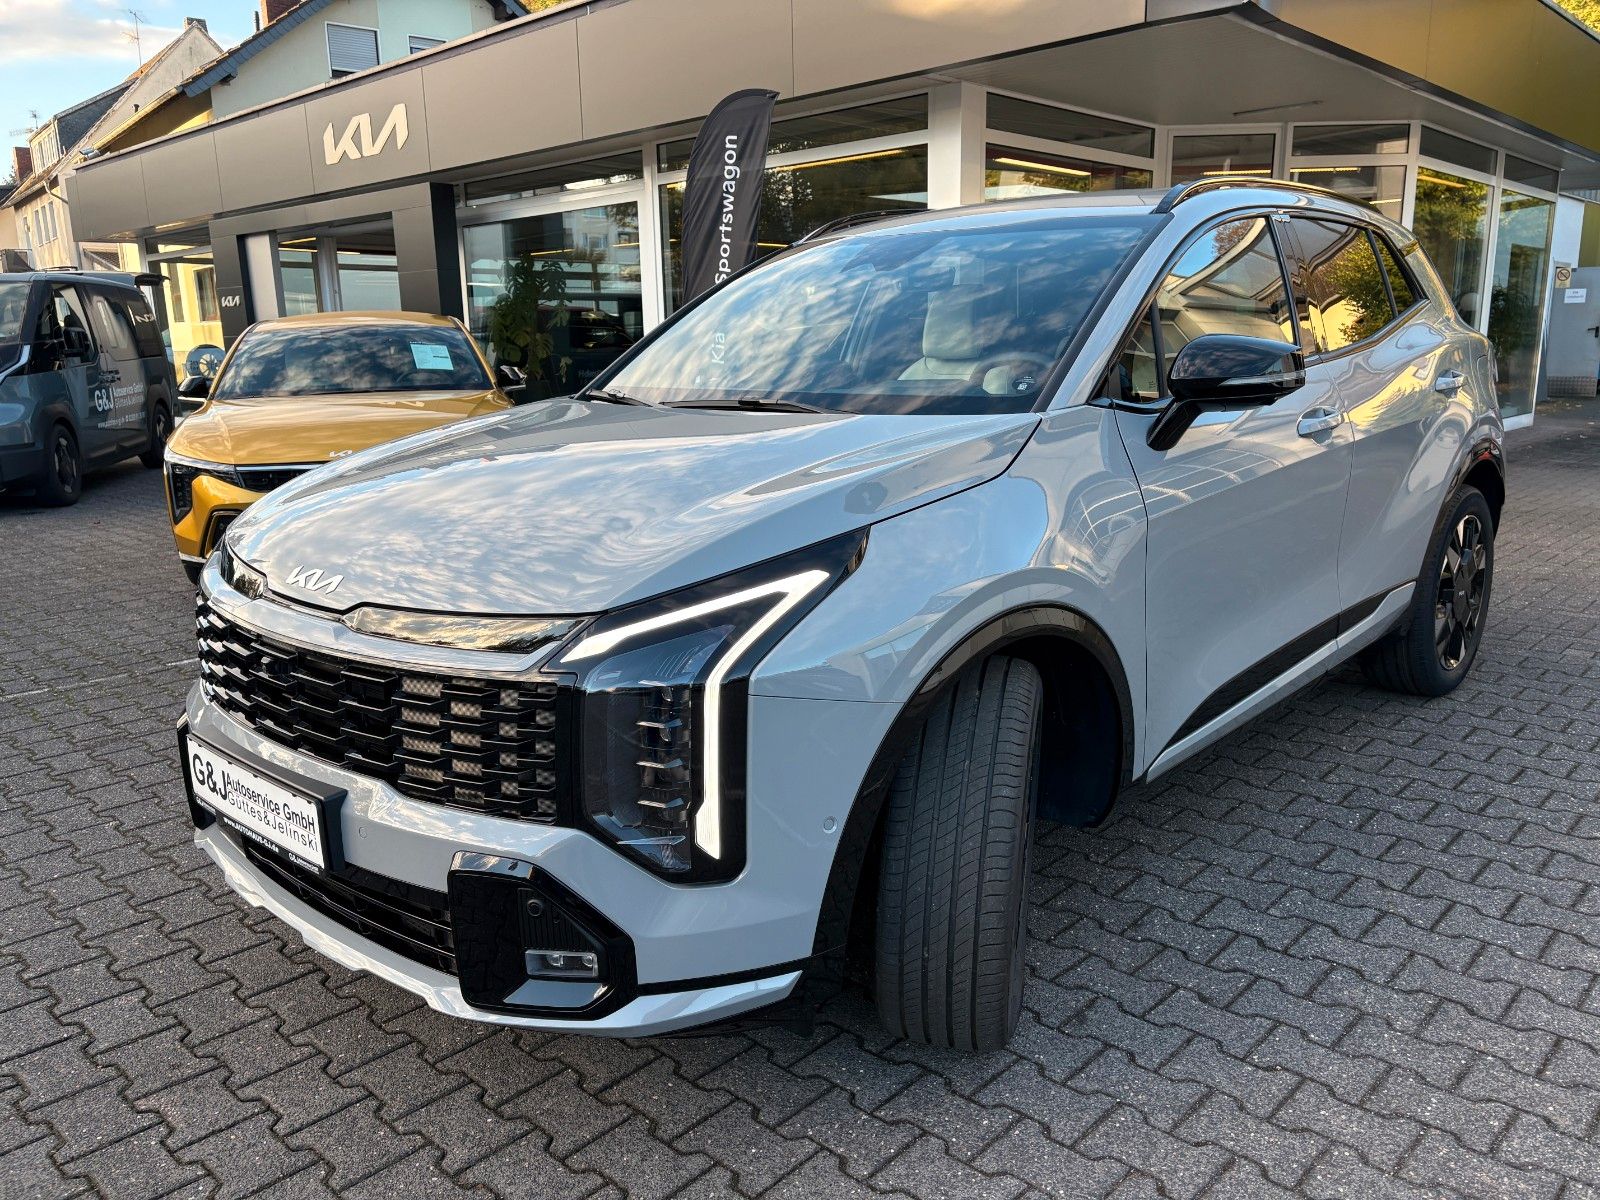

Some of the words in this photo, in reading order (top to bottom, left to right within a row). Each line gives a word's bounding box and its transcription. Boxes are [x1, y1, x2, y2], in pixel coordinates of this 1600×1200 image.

[323, 103, 409, 165] KIA
[714, 134, 741, 286] Sportswagon
[711, 332, 725, 364] Kia
[94, 387, 114, 411] G&J
[285, 564, 345, 595] KIA
[192, 753, 228, 801] G&J
[226, 772, 281, 816] Autoservice
[282, 802, 317, 835] GmbH
